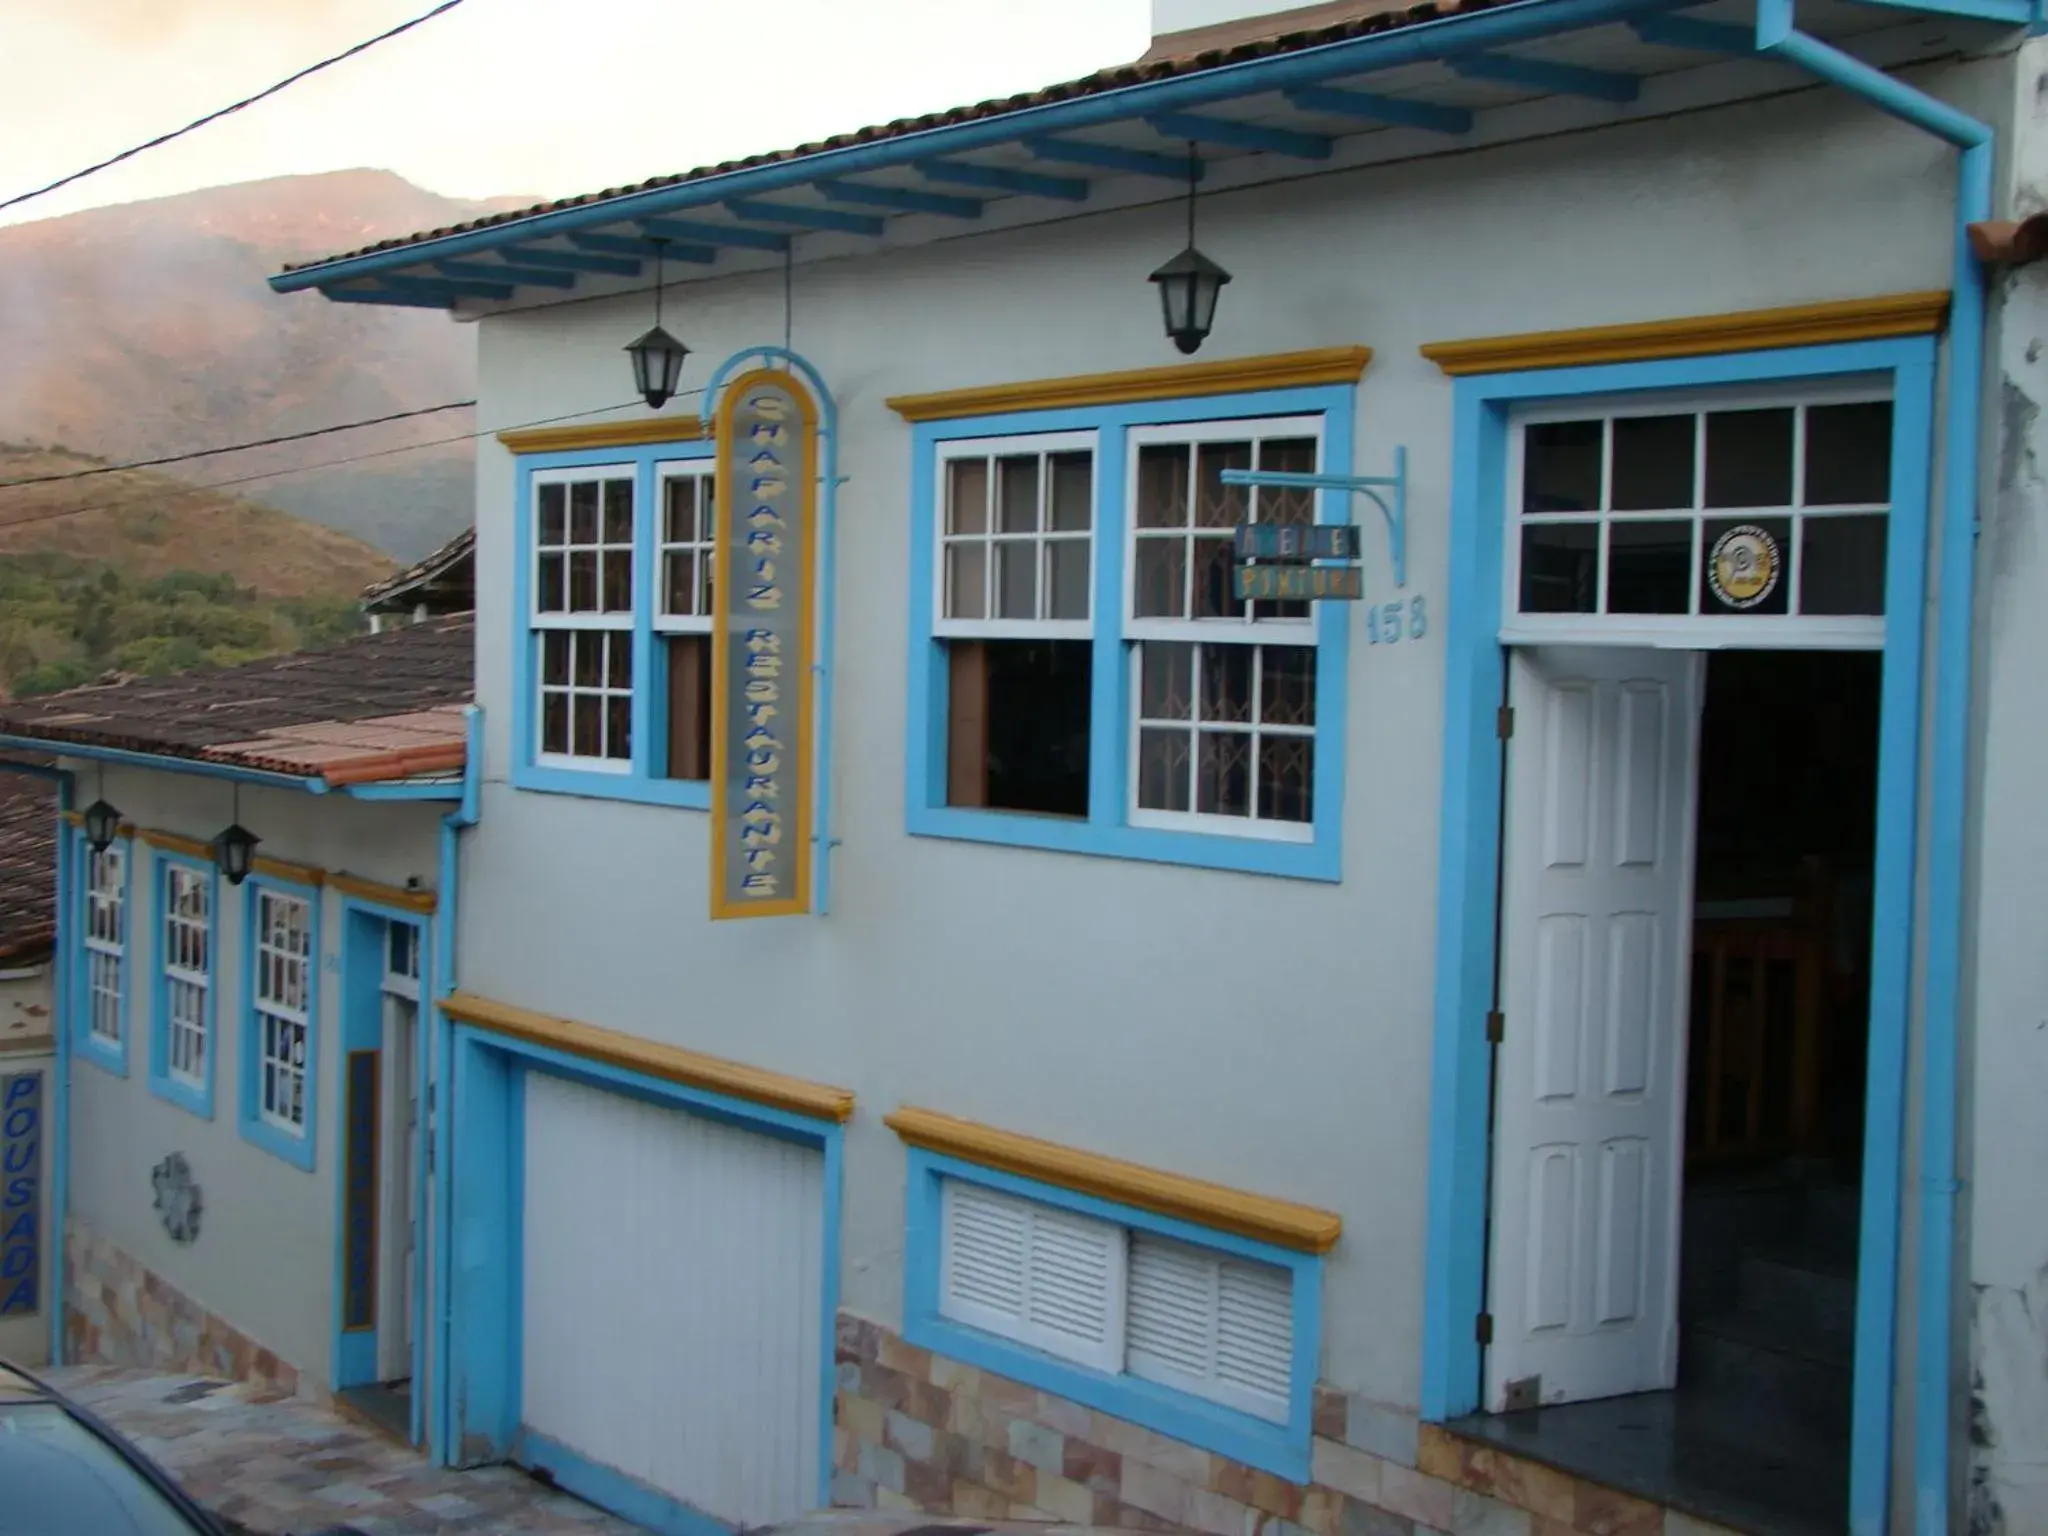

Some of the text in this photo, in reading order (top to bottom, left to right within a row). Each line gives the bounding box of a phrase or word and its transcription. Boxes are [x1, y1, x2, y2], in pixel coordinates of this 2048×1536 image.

[741, 396, 790, 897] CHAFARIZ RESTAURANTE
[1366, 594, 1427, 645] 158
[2, 1076, 38, 1316] POUSADA
